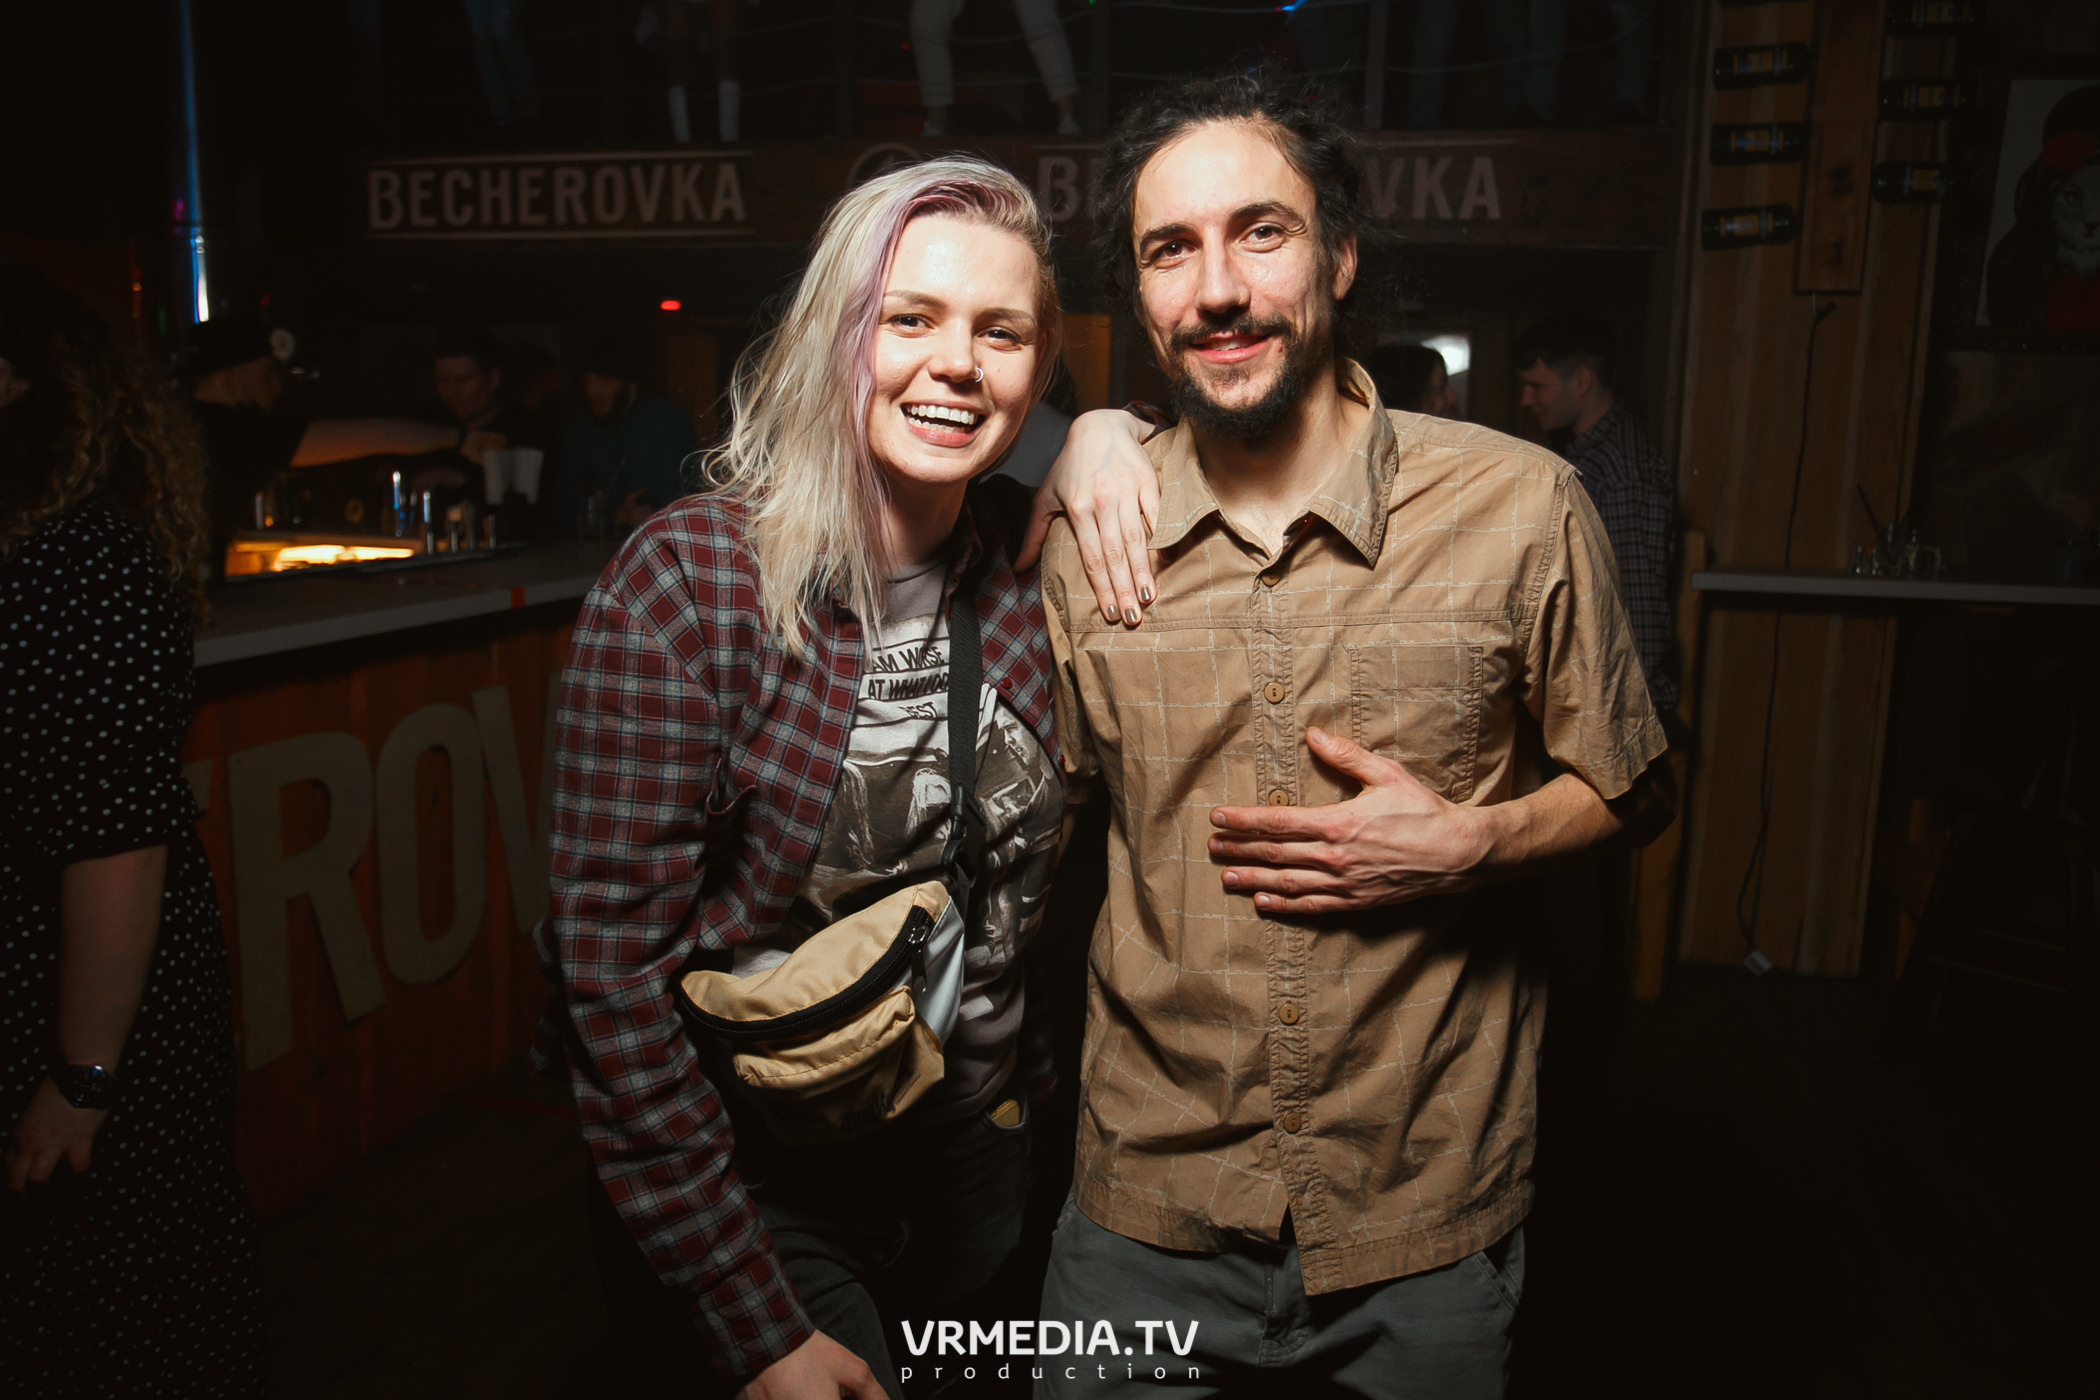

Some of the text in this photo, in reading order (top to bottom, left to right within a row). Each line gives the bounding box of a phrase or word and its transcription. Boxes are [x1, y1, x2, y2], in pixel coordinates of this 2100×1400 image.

[368, 161, 747, 230] BECHEROVKA
[867, 679, 885, 700] AT
[888, 677, 927, 700] WHAT
